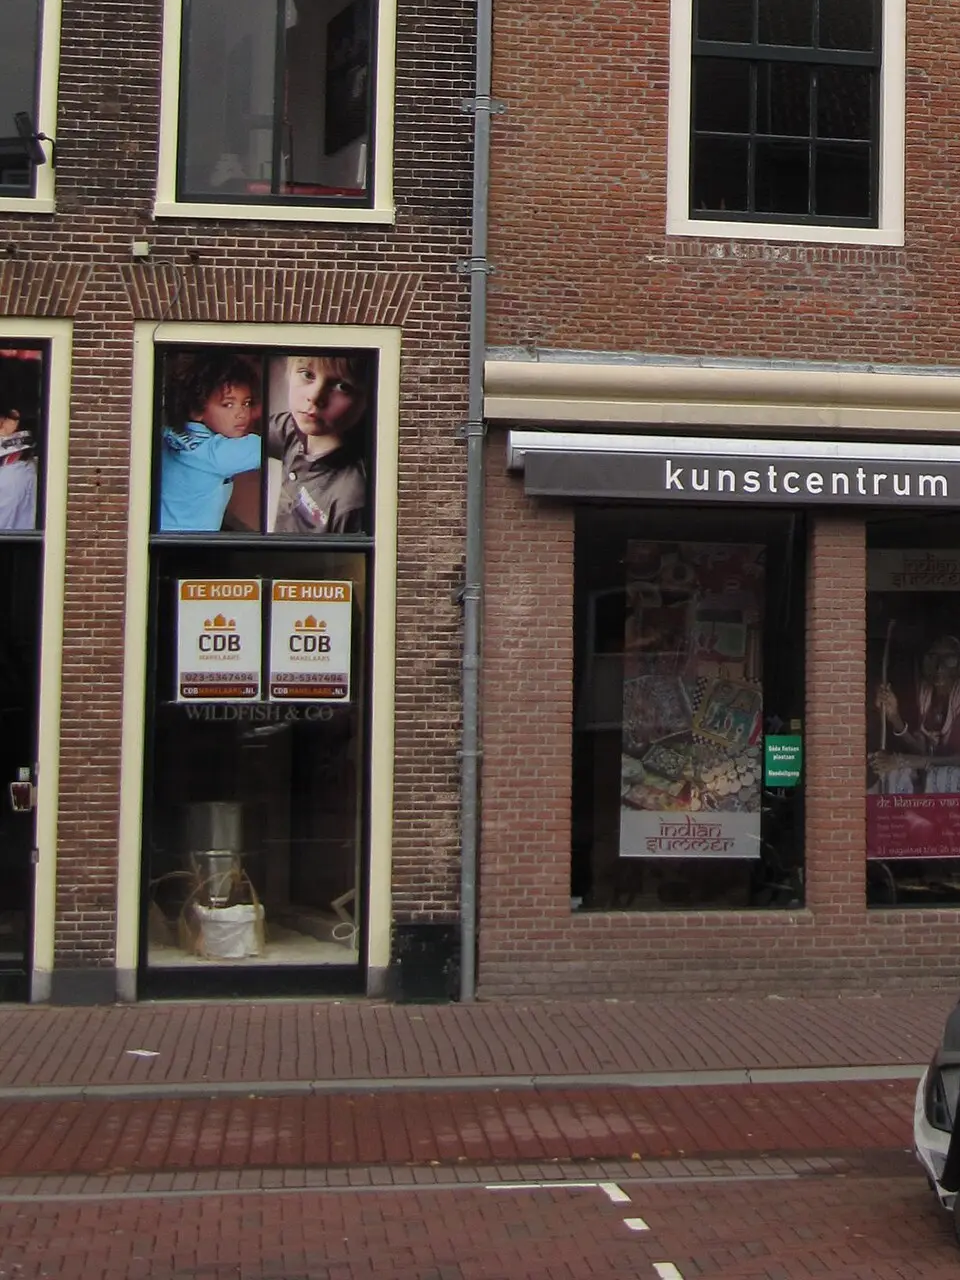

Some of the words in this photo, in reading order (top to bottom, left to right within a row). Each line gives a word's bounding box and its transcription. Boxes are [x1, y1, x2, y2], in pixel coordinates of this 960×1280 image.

[666, 459, 948, 496] kunstcentrum
[187, 584, 207, 597] TE
[210, 584, 254, 597] KOOP
[278, 585, 297, 599] TE
[301, 585, 345, 599] HUUR
[199, 634, 241, 652] CDB
[289, 635, 331, 653] CDB
[185, 705, 281, 720] WILDFISH
[285, 705, 299, 720] &
[305, 705, 334, 720] CO
[659, 814, 722, 837] indian
[645, 836, 735, 853] summer
